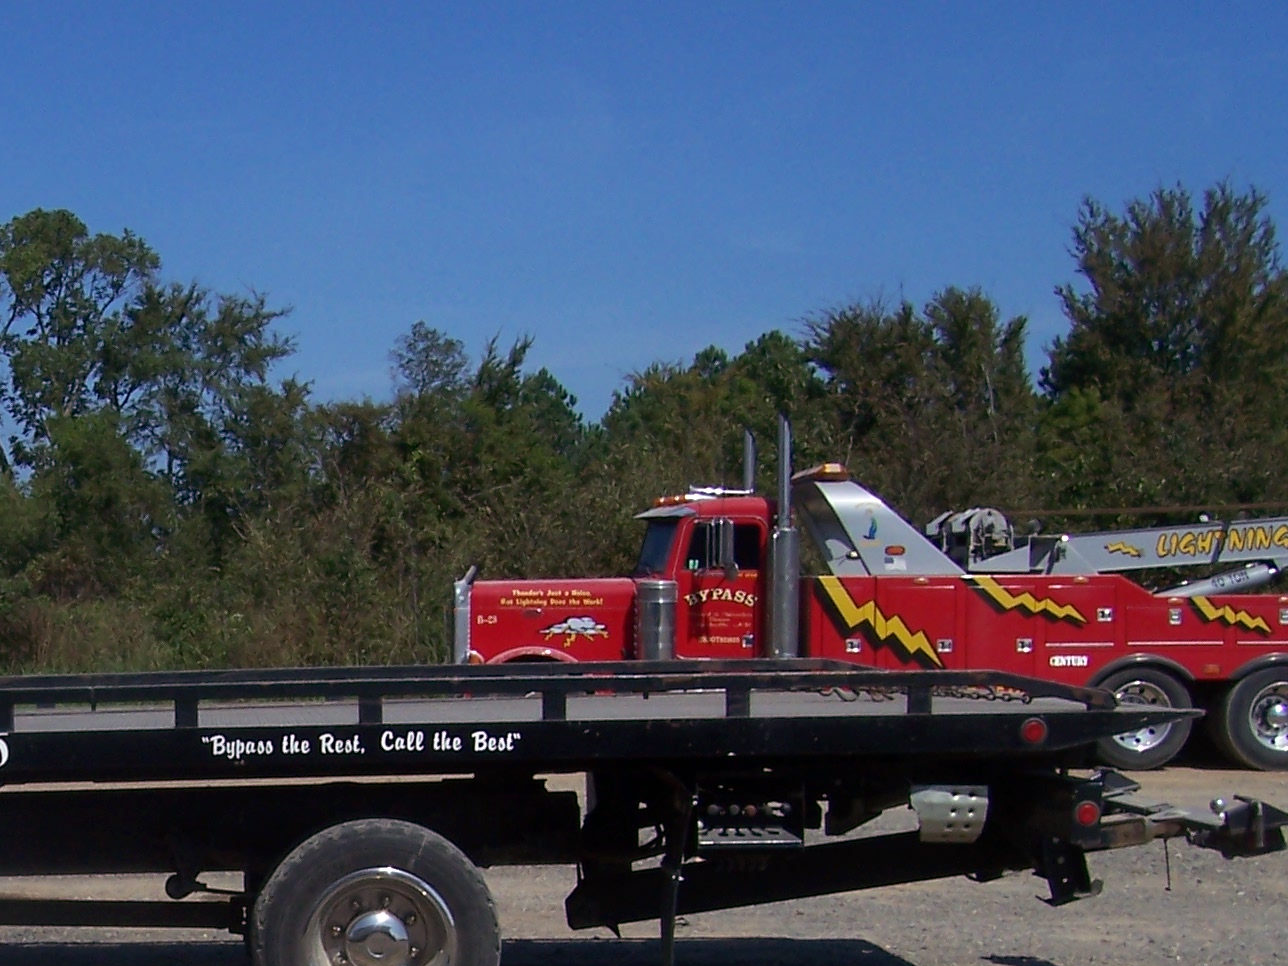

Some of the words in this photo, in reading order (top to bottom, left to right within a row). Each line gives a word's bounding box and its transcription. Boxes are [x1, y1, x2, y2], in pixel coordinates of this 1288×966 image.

[683, 587, 755, 608] BYPASS
[1049, 654, 1089, 667] CENTURY
[281, 733, 311, 755] the
[380, 730, 425, 752] Call
[432, 730, 463, 751] the
